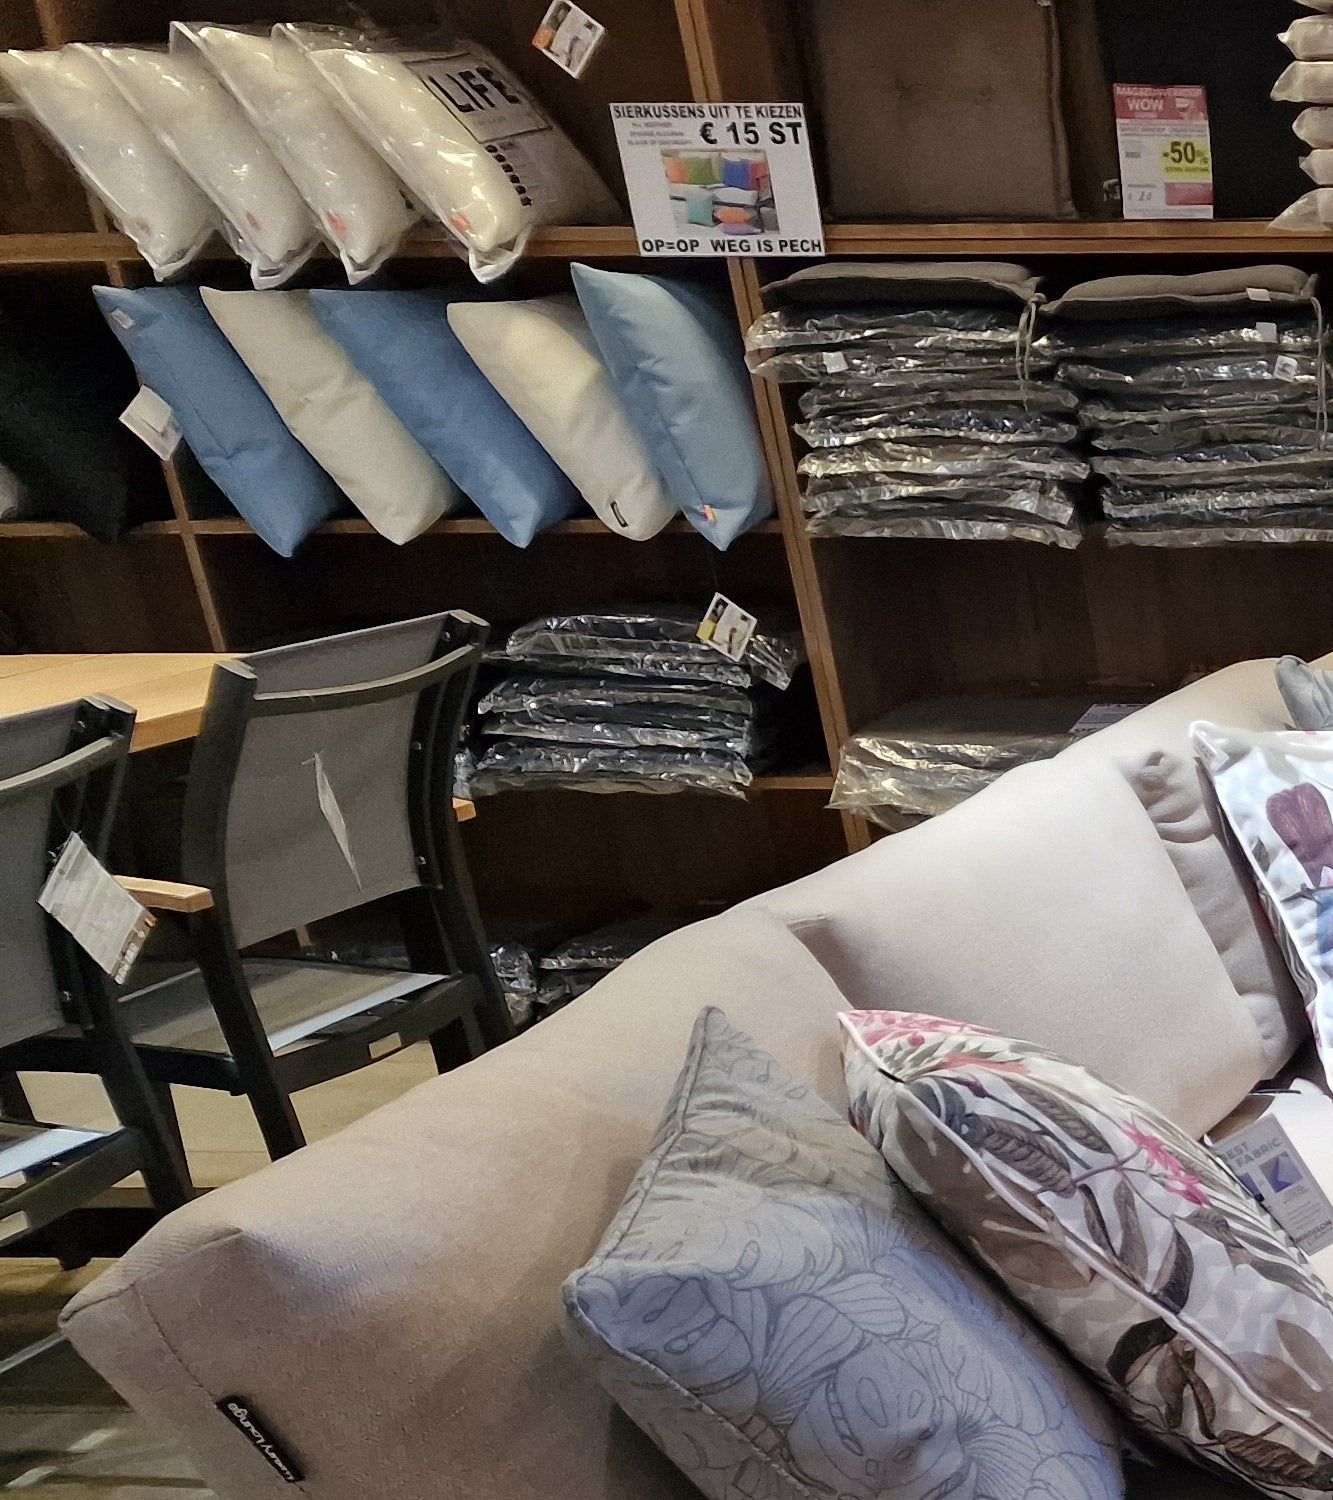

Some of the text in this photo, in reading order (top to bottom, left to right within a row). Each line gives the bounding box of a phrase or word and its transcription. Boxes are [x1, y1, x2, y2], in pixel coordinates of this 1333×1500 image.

[428, 65, 521, 113] LIFE
[613, 105, 802, 119] SIERKUSSENS UIT TE KIEZEN
[1127, 97, 1164, 112] WOW
[699, 121, 802, 145] € 15 ST
[642, 238, 822, 253] OP=OP WEG IS PECH
